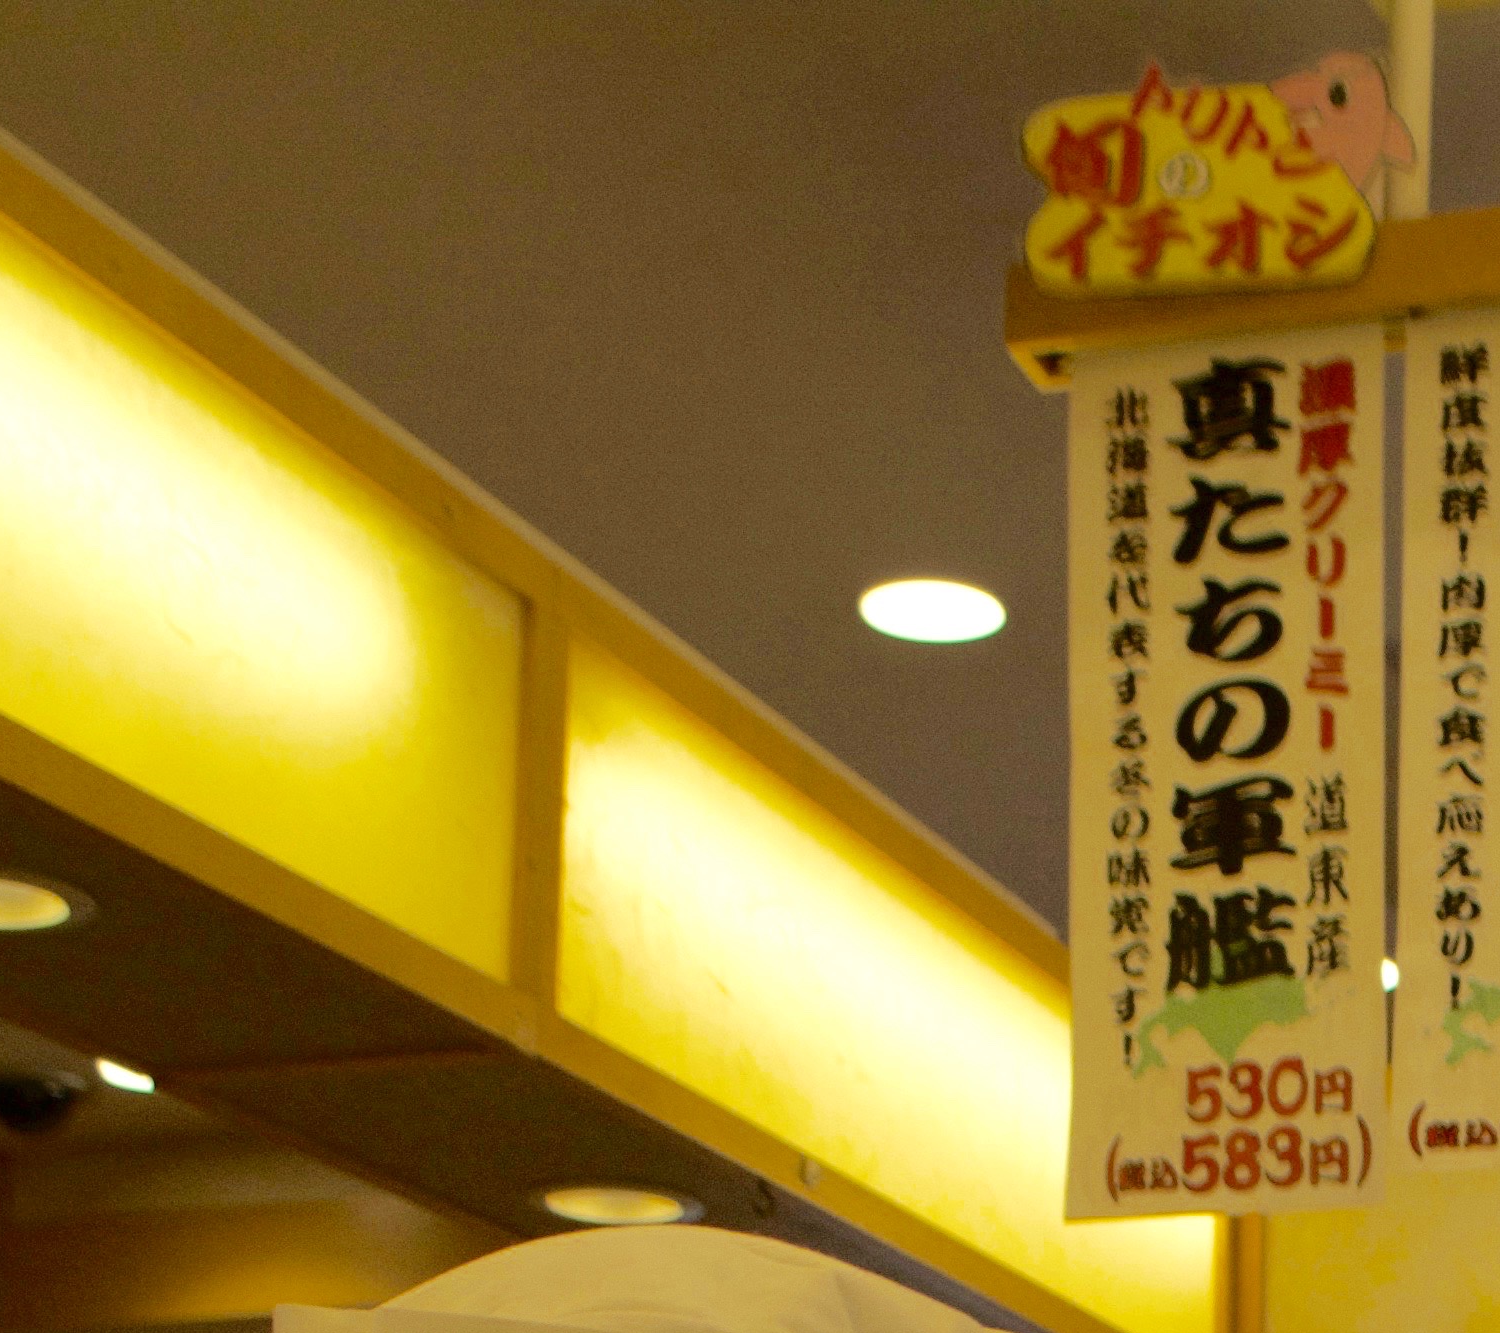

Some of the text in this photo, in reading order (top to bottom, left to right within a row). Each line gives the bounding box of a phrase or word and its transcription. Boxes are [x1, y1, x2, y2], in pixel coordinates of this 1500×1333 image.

[1047, 119, 1211, 208] 旬の
[1045, 195, 1360, 285] イチオシ
[1166, 355, 1296, 992] 真たちの軍艦
[1298, 357, 1357, 979] 濃厚クリーミー 道東産
[1184, 1055, 1354, 1124] 530円
[1105, 1115, 1373, 1204] (税込583円)
